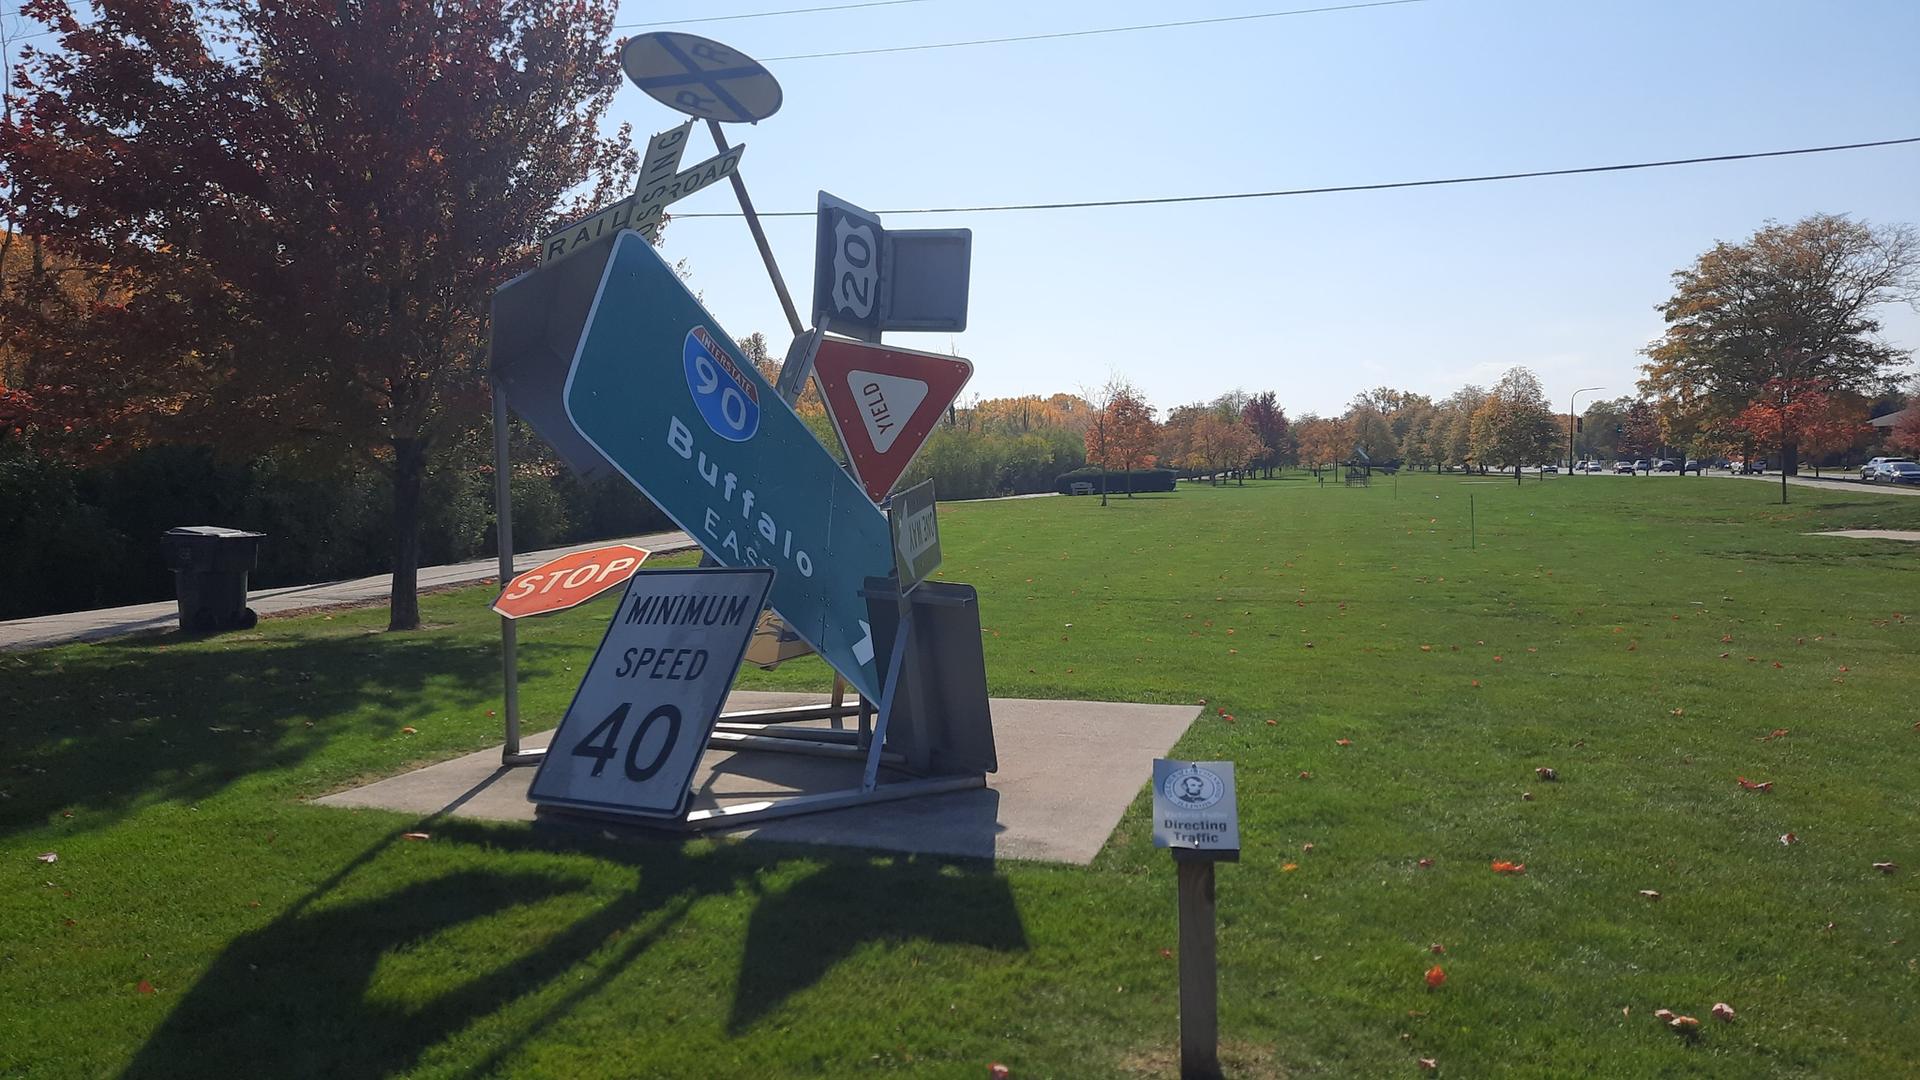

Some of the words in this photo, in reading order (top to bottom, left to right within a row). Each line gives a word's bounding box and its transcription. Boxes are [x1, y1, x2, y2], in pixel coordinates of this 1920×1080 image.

[548, 205, 635, 261] RAIL
[841, 234, 870, 307] 20
[701, 332, 753, 396] INTERSTATE
[696, 356, 746, 431] 90
[863, 382, 894, 435] YIELD
[667, 415, 813, 578] Buffalo
[704, 507, 769, 567] EAS
[506, 557, 636, 600] STOP
[625, 595, 750, 626] MINIMUM
[615, 648, 709, 681] SPEED
[571, 702, 682, 782] 40
[1164, 819, 1227, 832] Directing
[1174, 831, 1219, 843] Traffic
